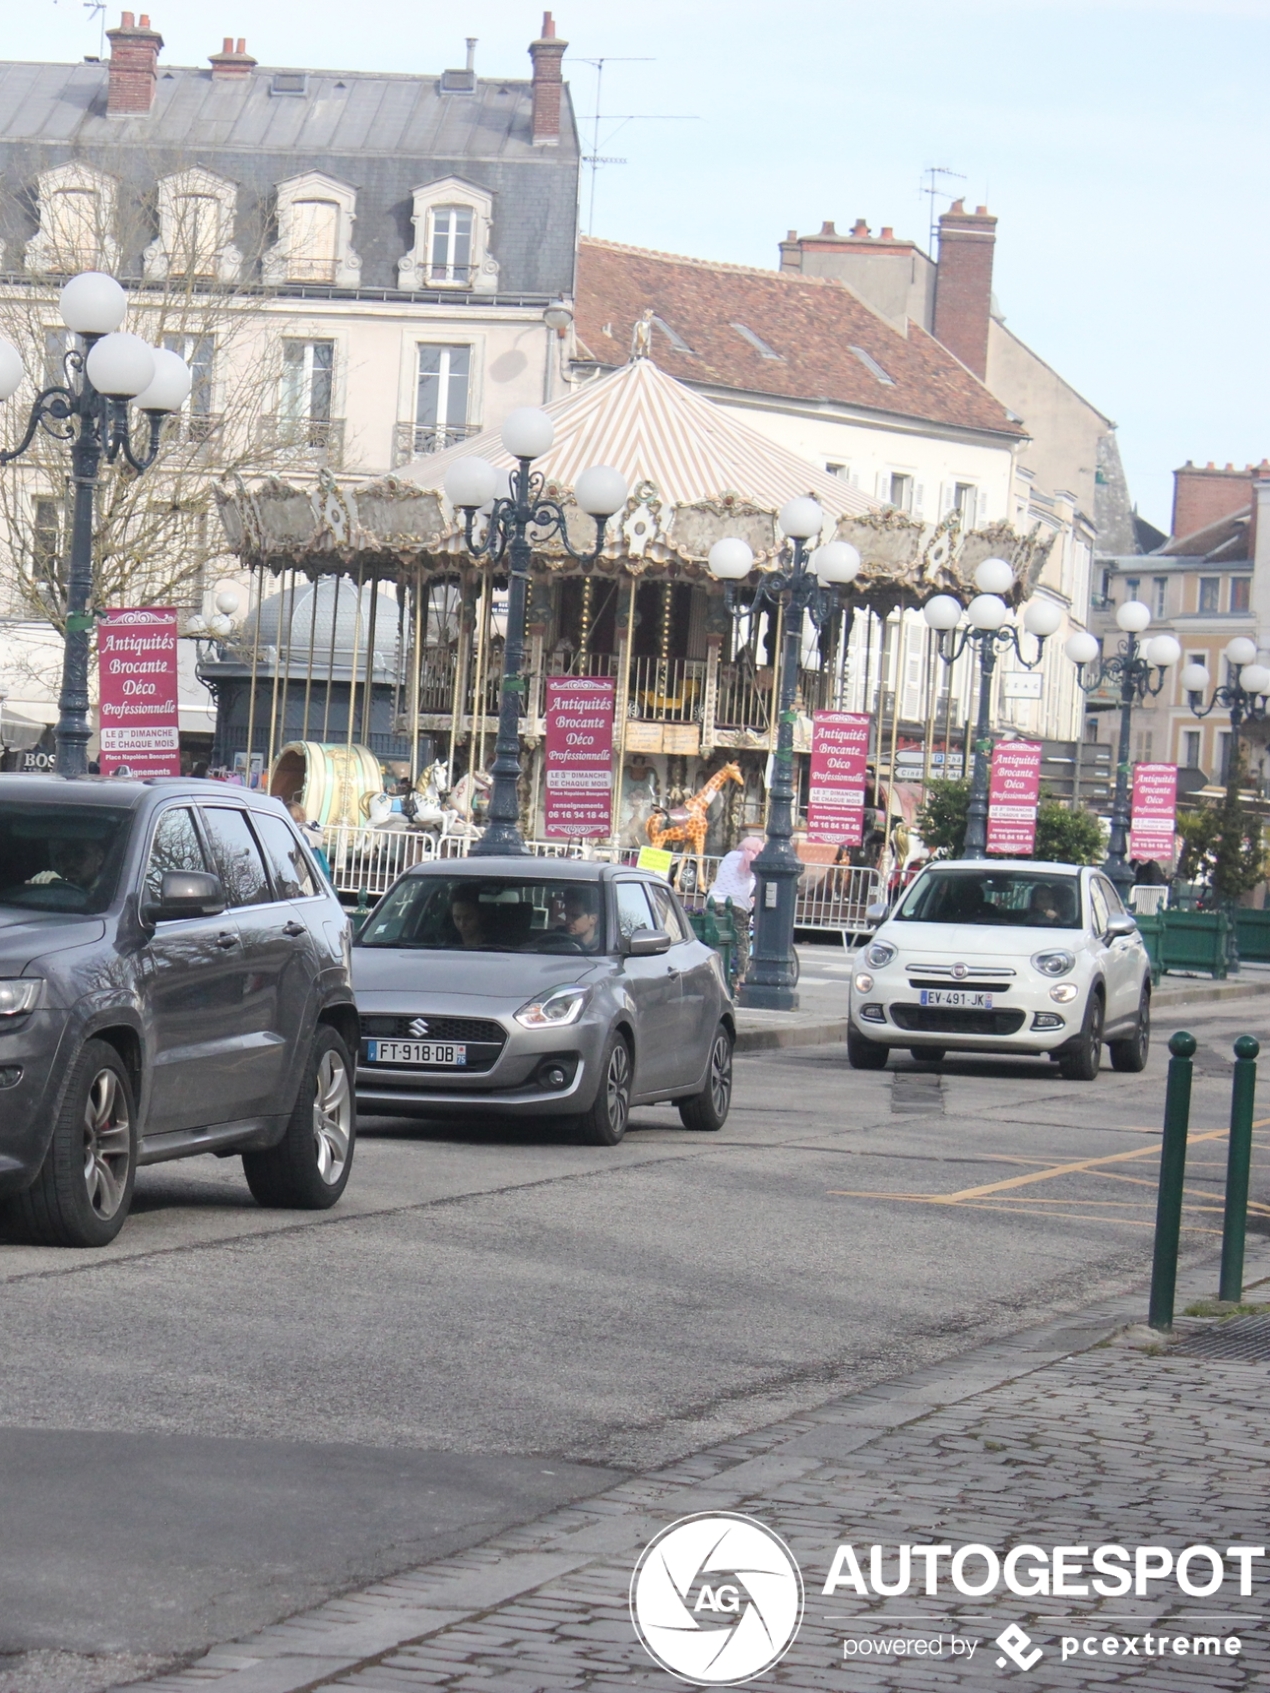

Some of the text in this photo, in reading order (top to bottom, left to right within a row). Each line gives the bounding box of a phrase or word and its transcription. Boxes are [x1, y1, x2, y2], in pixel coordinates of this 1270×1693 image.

[102, 632, 174, 656] Antiquités
[109, 659, 168, 674] Brocante
[122, 679, 157, 696] Déco
[102, 700, 176, 718] Professionnelle
[549, 697, 612, 714] Antiquités
[555, 716, 605, 729] Brocante
[131, 729, 173, 738] DIMANCHE
[566, 732, 594, 746] Déco
[814, 728, 866, 743] Antiquités
[118, 740, 152, 748] CHAQUE
[819, 743, 860, 755] Brocante
[24, 752, 56, 768] BOS
[549, 750, 610, 763] Professionnelle
[994, 754, 1039, 767] Antiquités
[827, 758, 851, 769] Déco
[109, 768, 170, 778] rignements
[812, 771, 863, 783] Professionnelle
[997, 767, 1033, 777] Brocante
[1004, 780, 1025, 789] Déco
[991, 791, 1036, 801] Professionnelle
[928, 992, 984, 1006] EV-491-JK
[380, 1044, 454, 1062] FT-918-DB
[457, 1055, 466, 1064] 75
